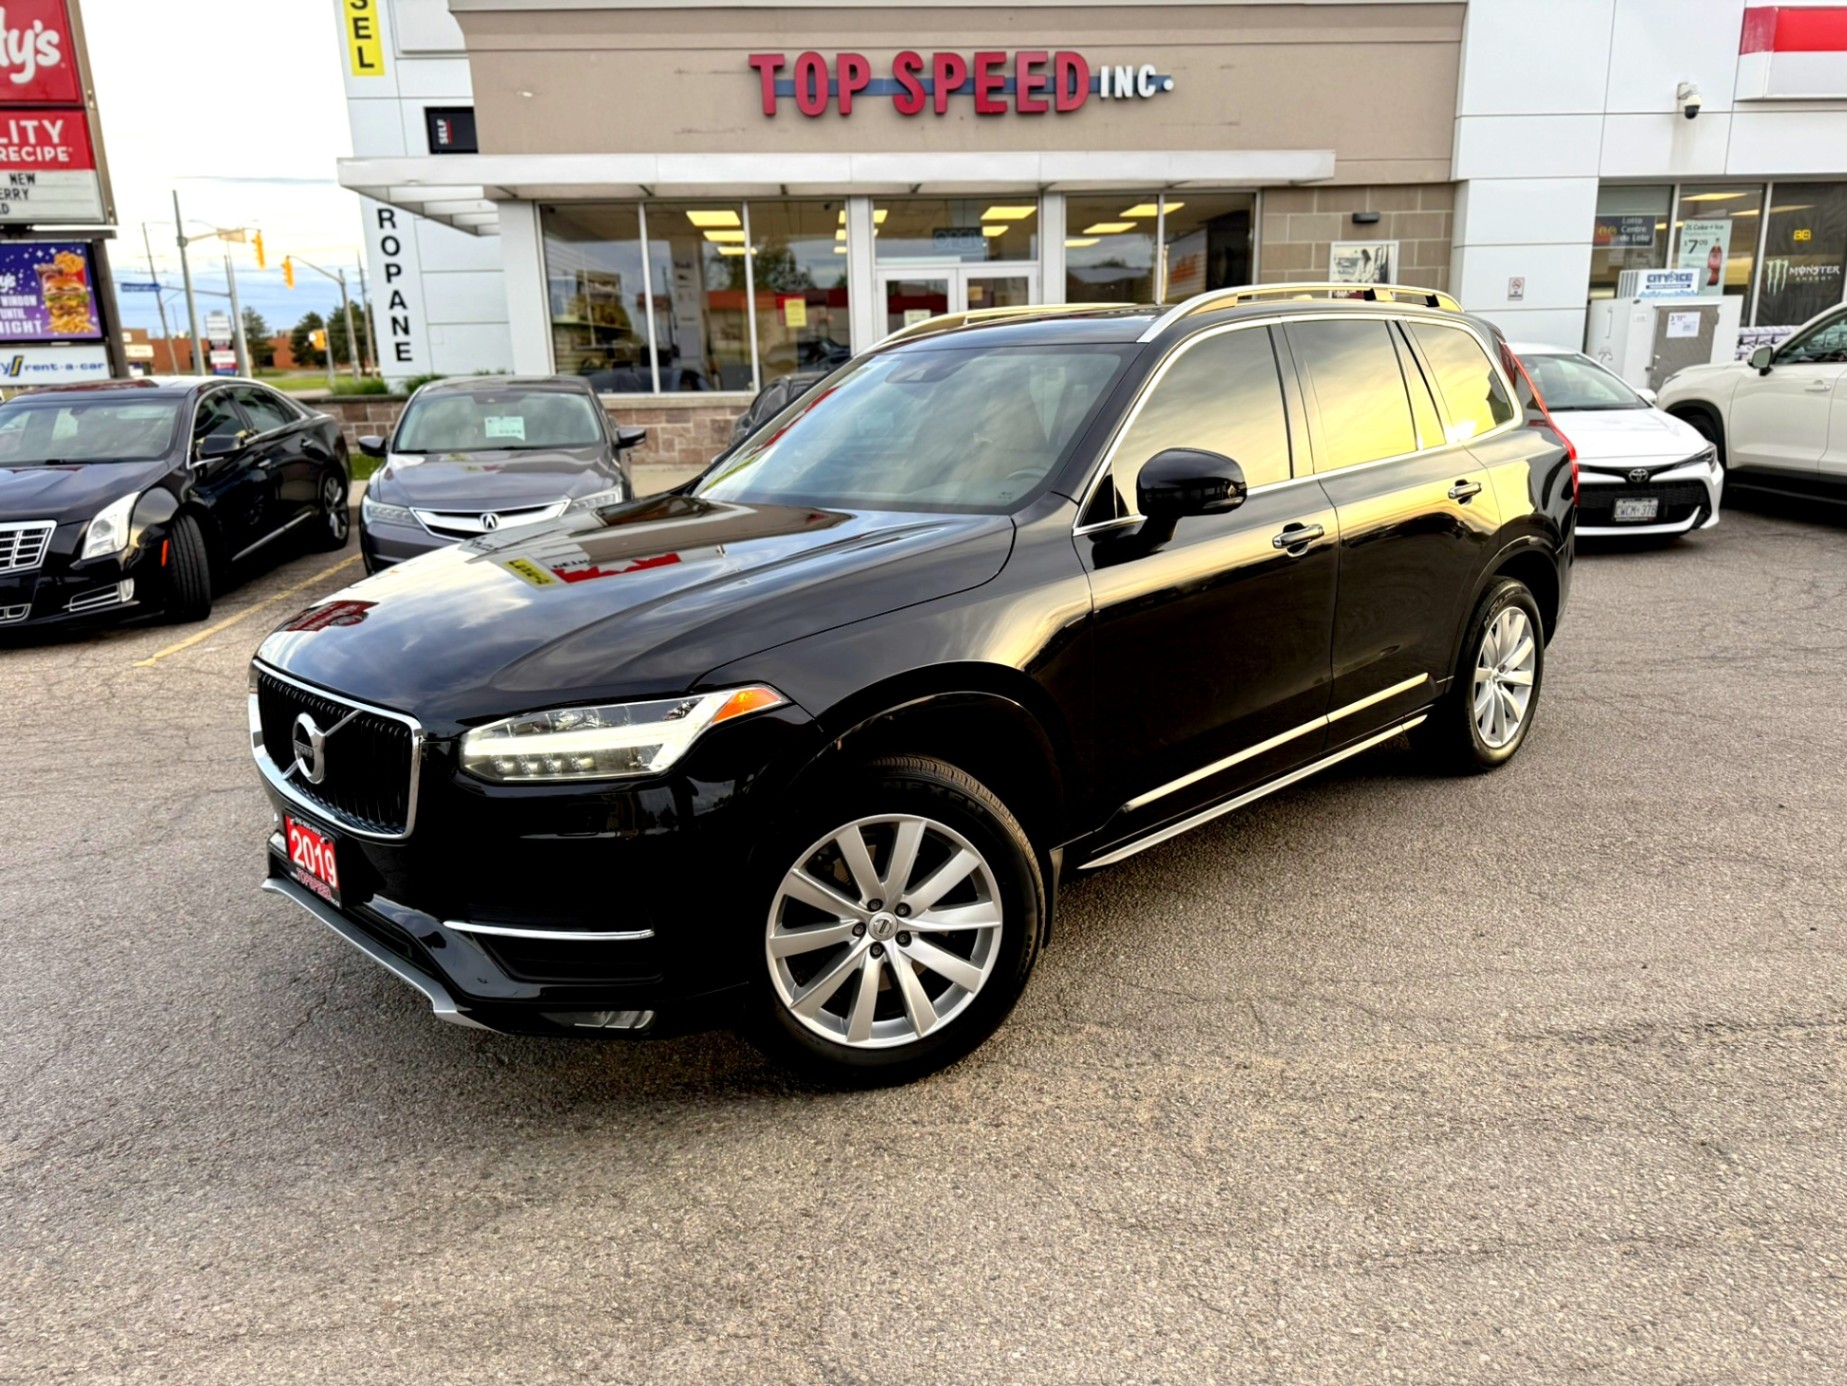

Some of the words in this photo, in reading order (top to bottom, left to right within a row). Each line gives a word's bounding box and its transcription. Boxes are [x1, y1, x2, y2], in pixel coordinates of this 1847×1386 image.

[748, 53, 871, 117] TOP
[892, 50, 1090, 116] SPEED
[436, 118, 449, 145] SELF
[9, 173, 36, 186] NEW
[1621, 225, 1647, 234] Centre
[1622, 217, 1643, 225] Lotto
[1789, 265, 1840, 276] MONSTER
[377, 208, 413, 362] ROPANE
[291, 829, 337, 888] 2019
